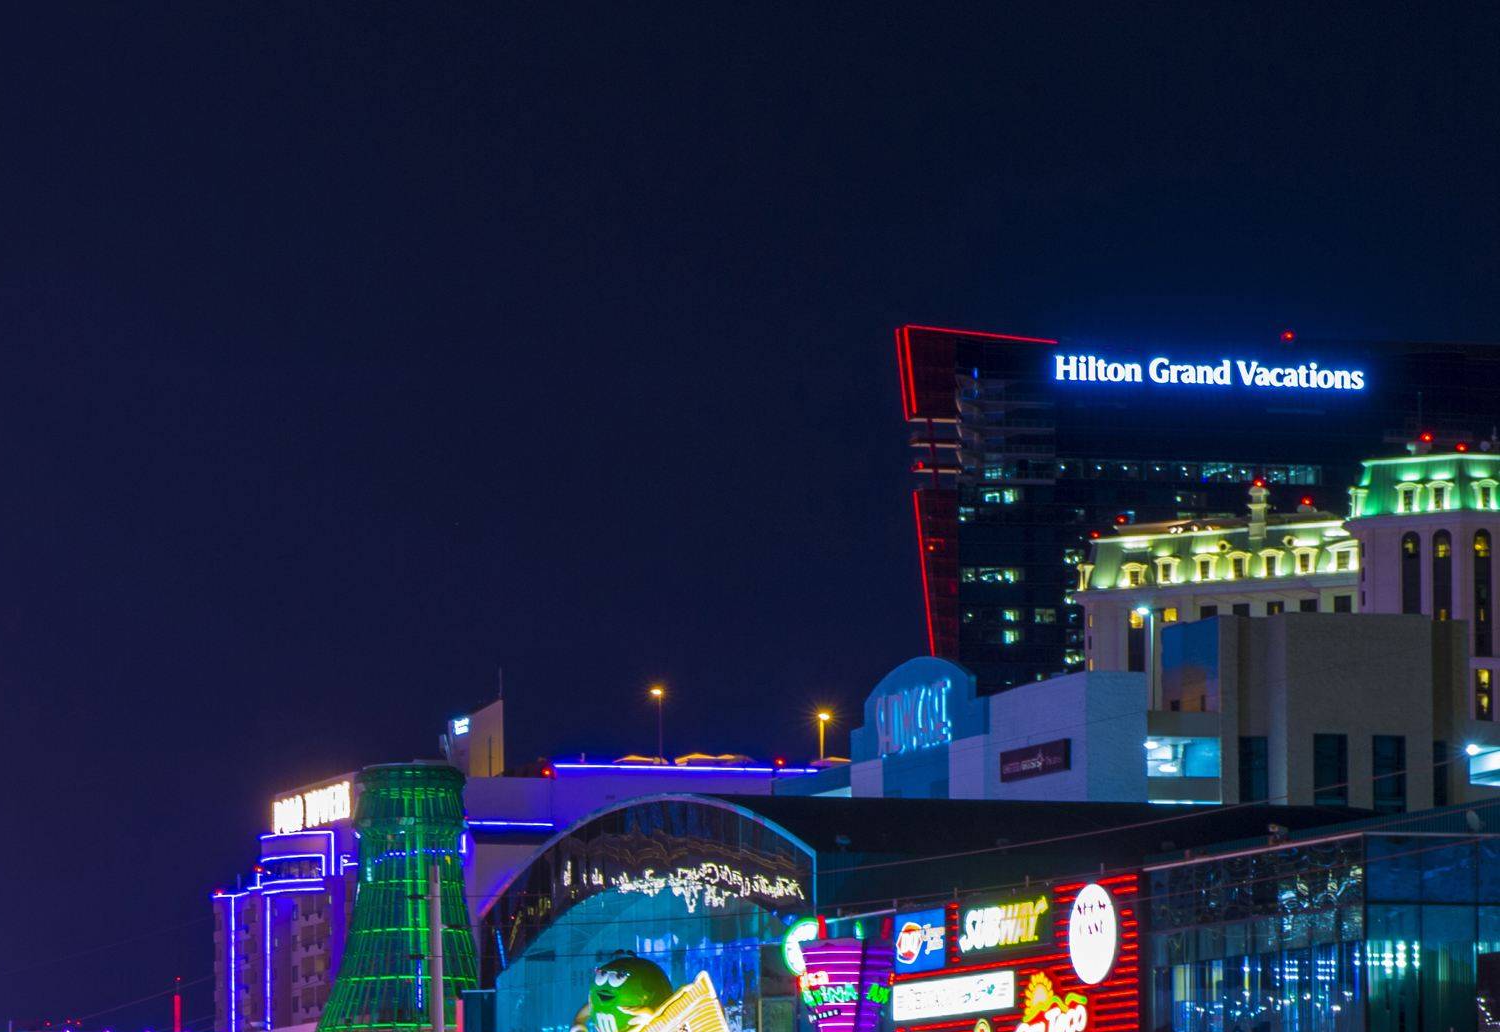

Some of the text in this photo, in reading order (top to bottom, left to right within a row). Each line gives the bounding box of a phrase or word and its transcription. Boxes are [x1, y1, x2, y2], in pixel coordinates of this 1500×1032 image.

[1055, 354, 1365, 390] Hilton Grand Vacations
[958, 895, 1048, 953] SUBWAY
